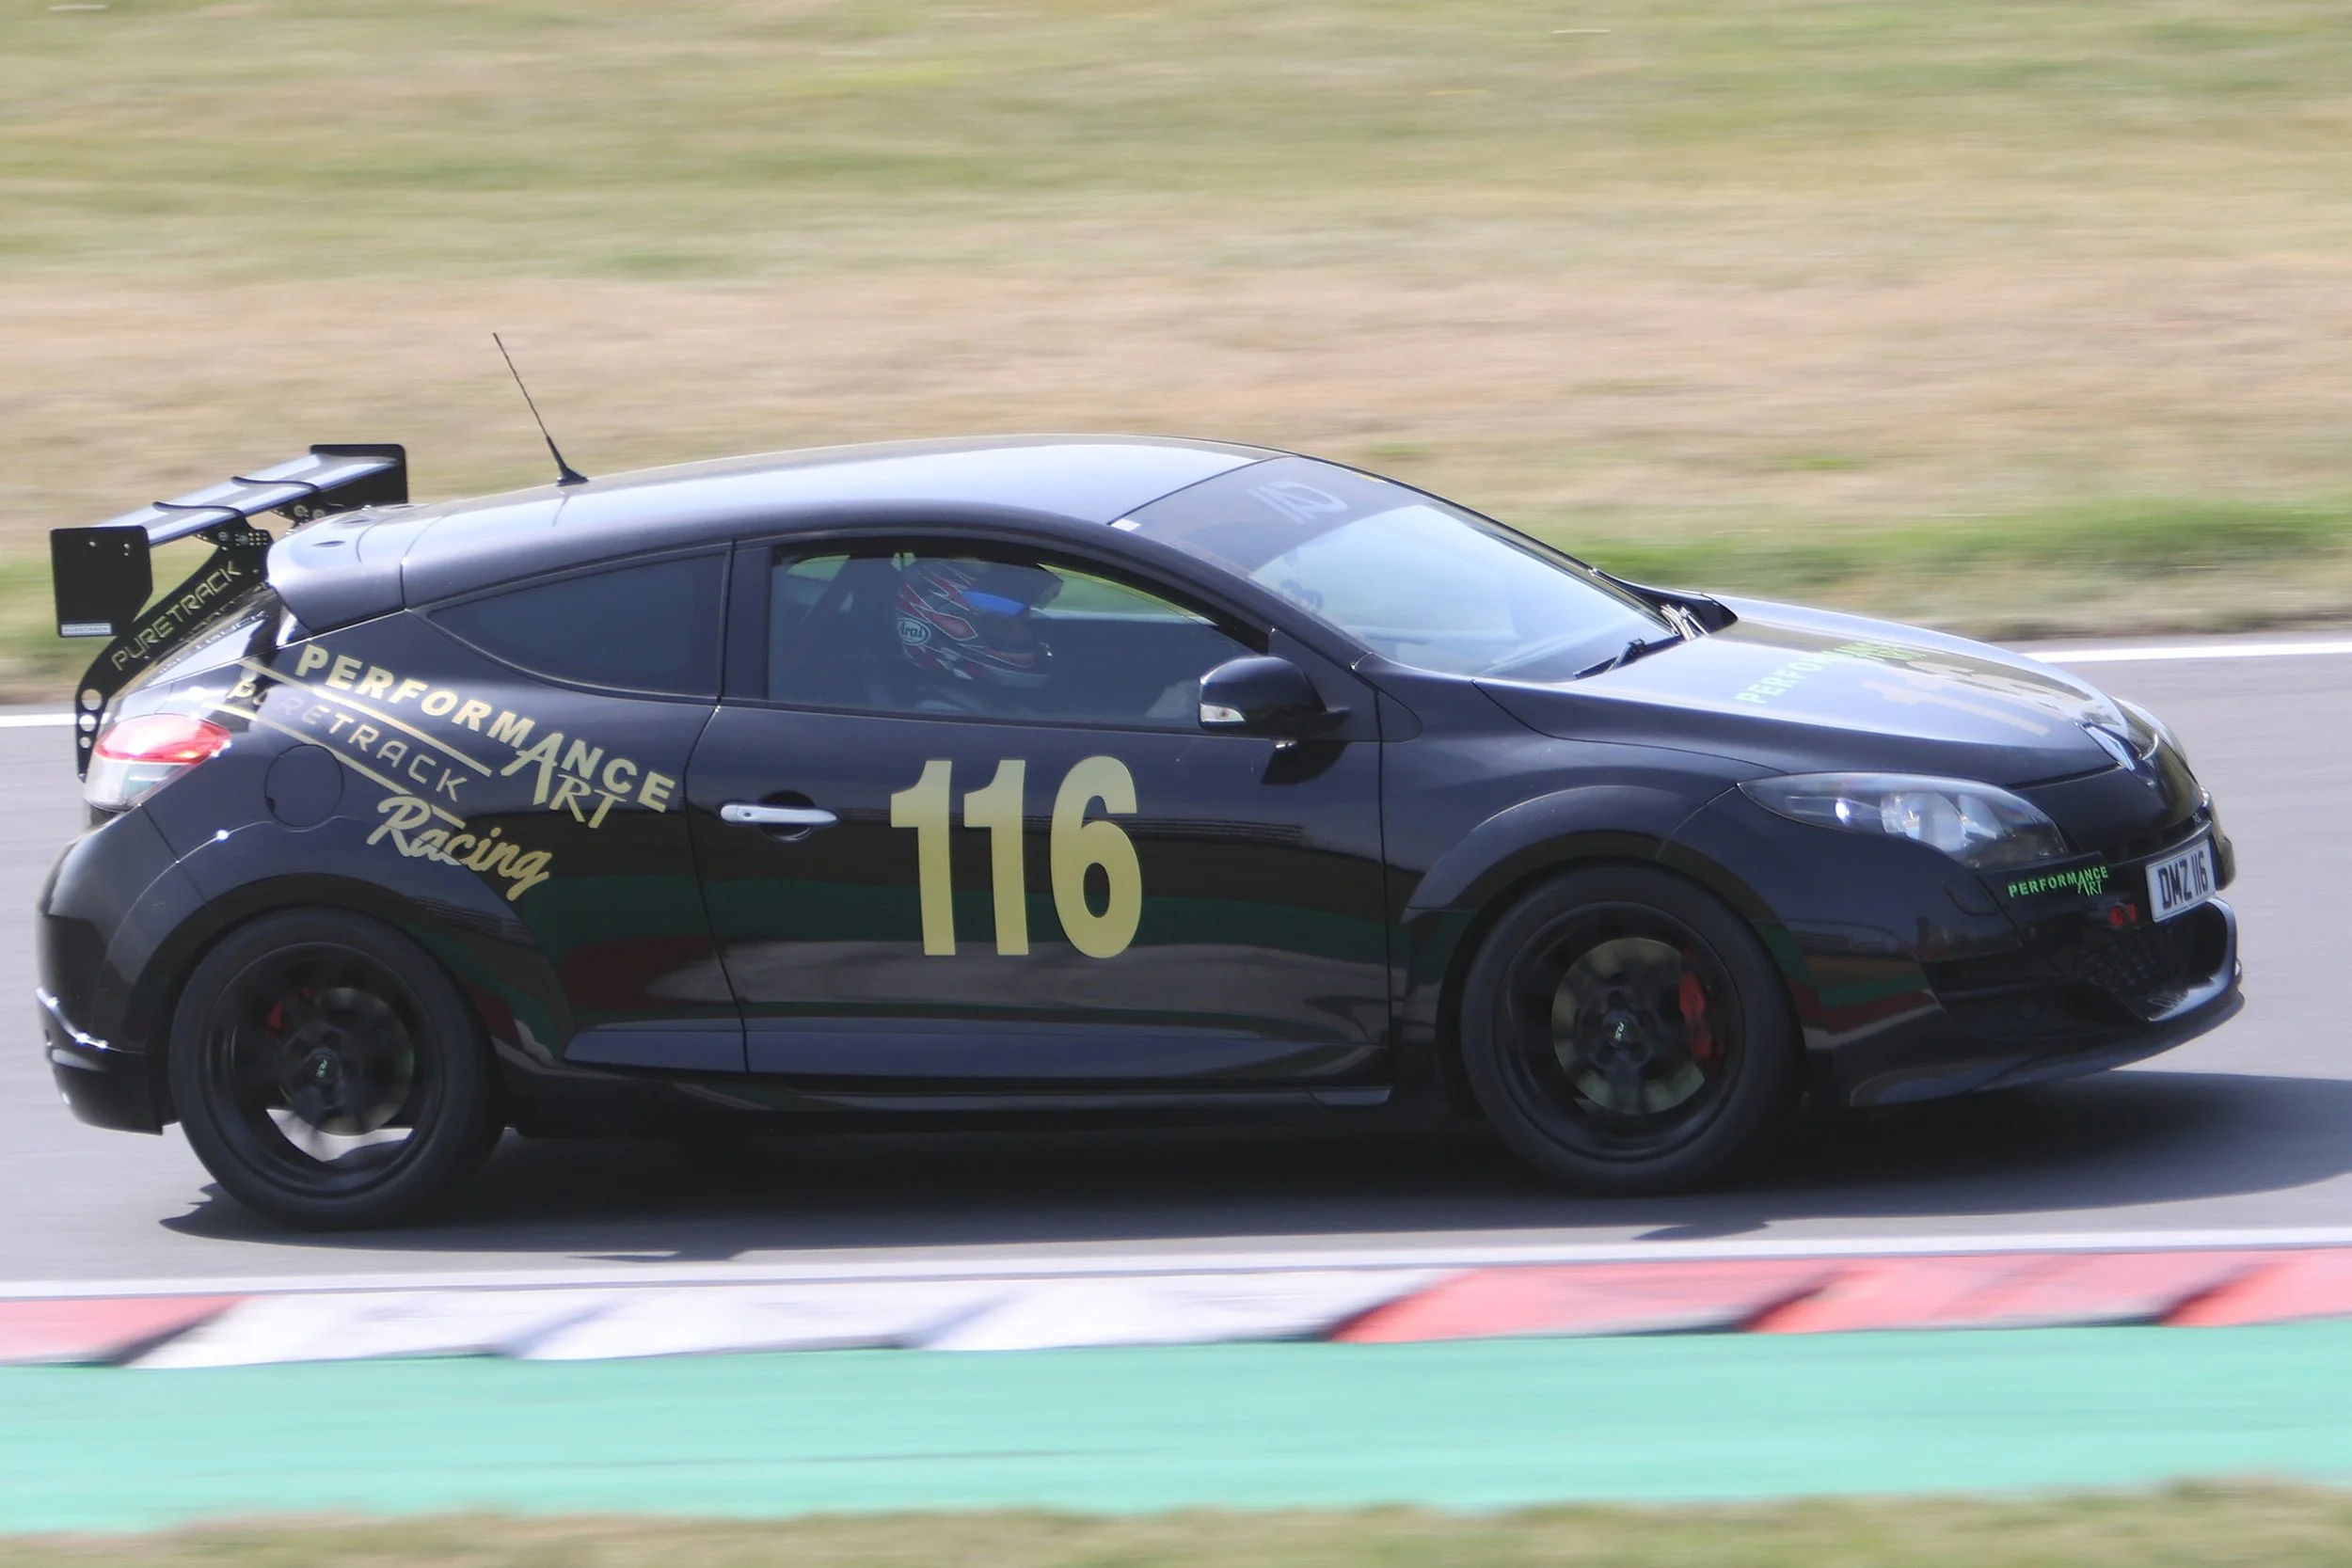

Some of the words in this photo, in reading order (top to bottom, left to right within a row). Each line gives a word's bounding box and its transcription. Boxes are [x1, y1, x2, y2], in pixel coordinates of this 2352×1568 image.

[110, 561, 242, 672] PURETRACK
[294, 643, 675, 814] PERFORMANCE
[366, 792, 553, 901] Racing
[890, 755, 1142, 958] 116
[2008, 865, 2109, 898] PERFORMANCE
[2157, 858, 2193, 910] DMZ
[2190, 850, 2209, 896] 116
